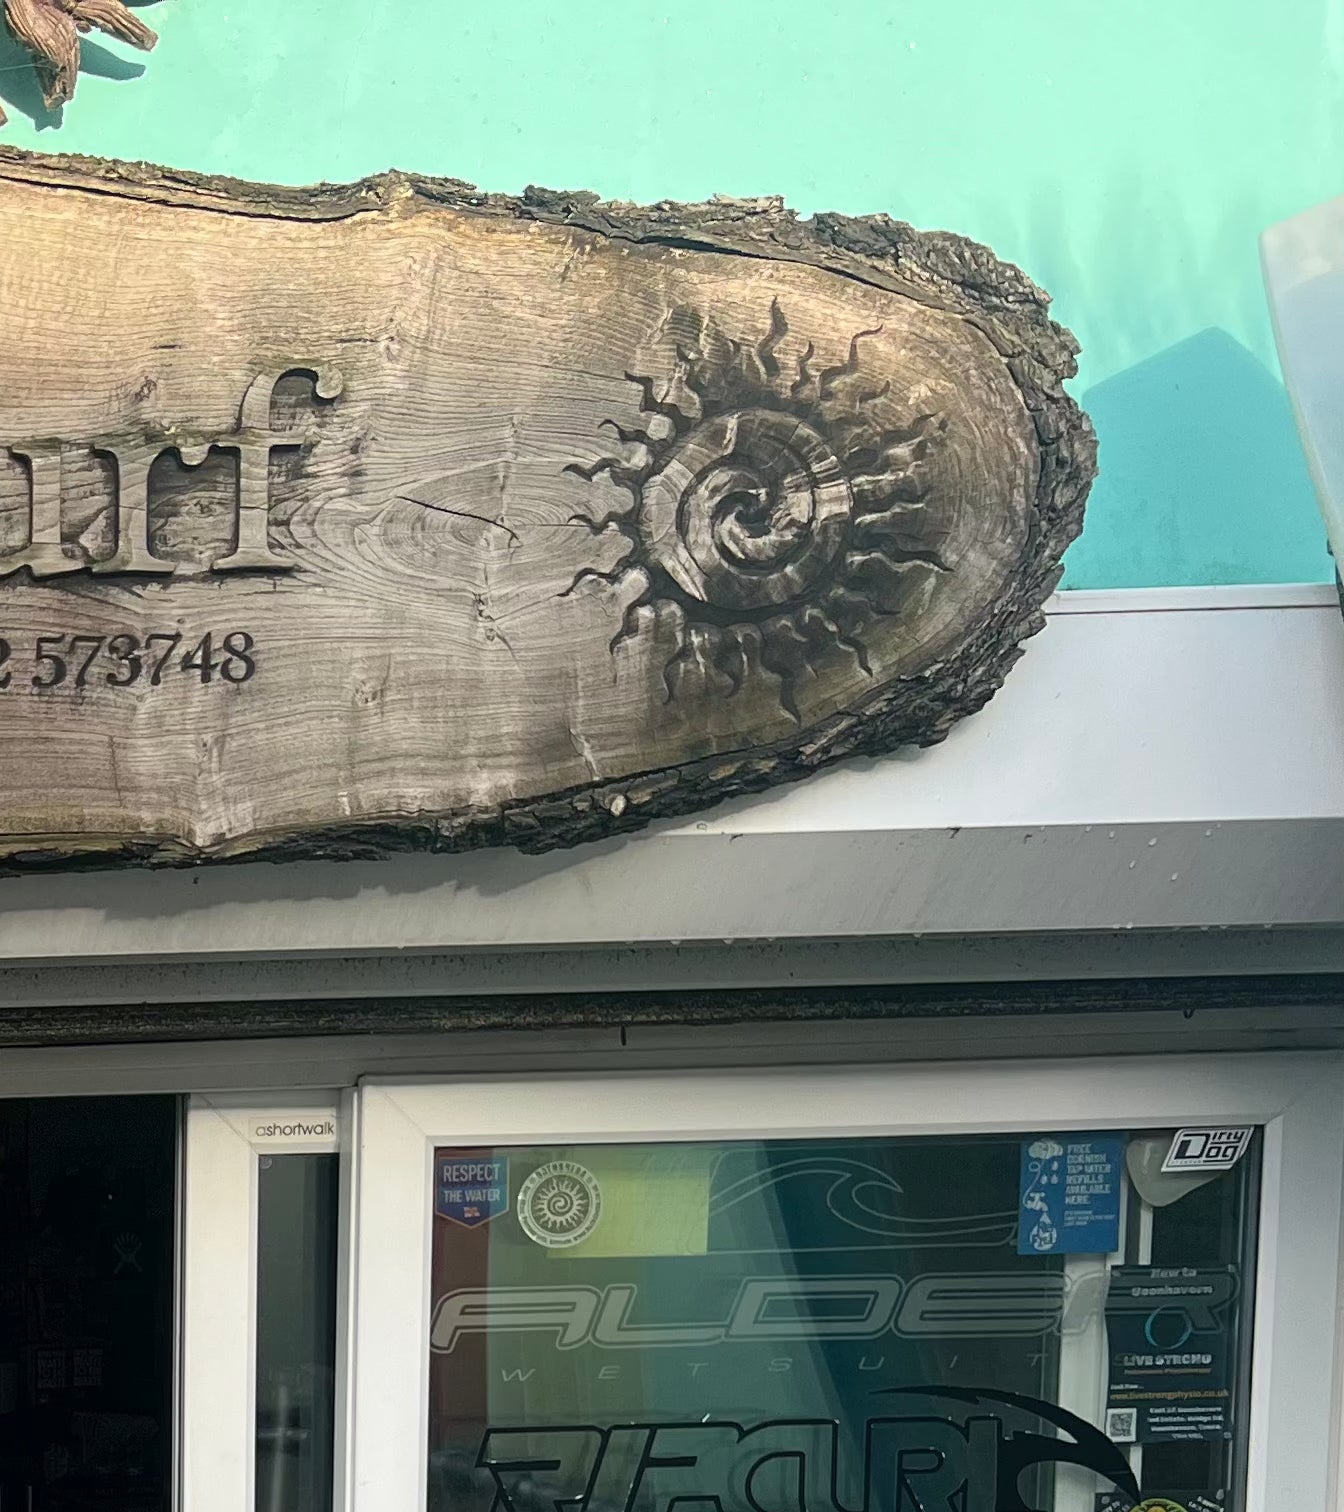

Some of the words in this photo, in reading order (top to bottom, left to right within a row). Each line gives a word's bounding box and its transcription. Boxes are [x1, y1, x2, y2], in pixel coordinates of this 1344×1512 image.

[31, 631, 256, 690] 573748
[443, 1163, 501, 1183] RESPECT
[443, 1189, 463, 1203] THE
[464, 1188, 501, 1202] WATER
[430, 1270, 1240, 1355] ALDER
